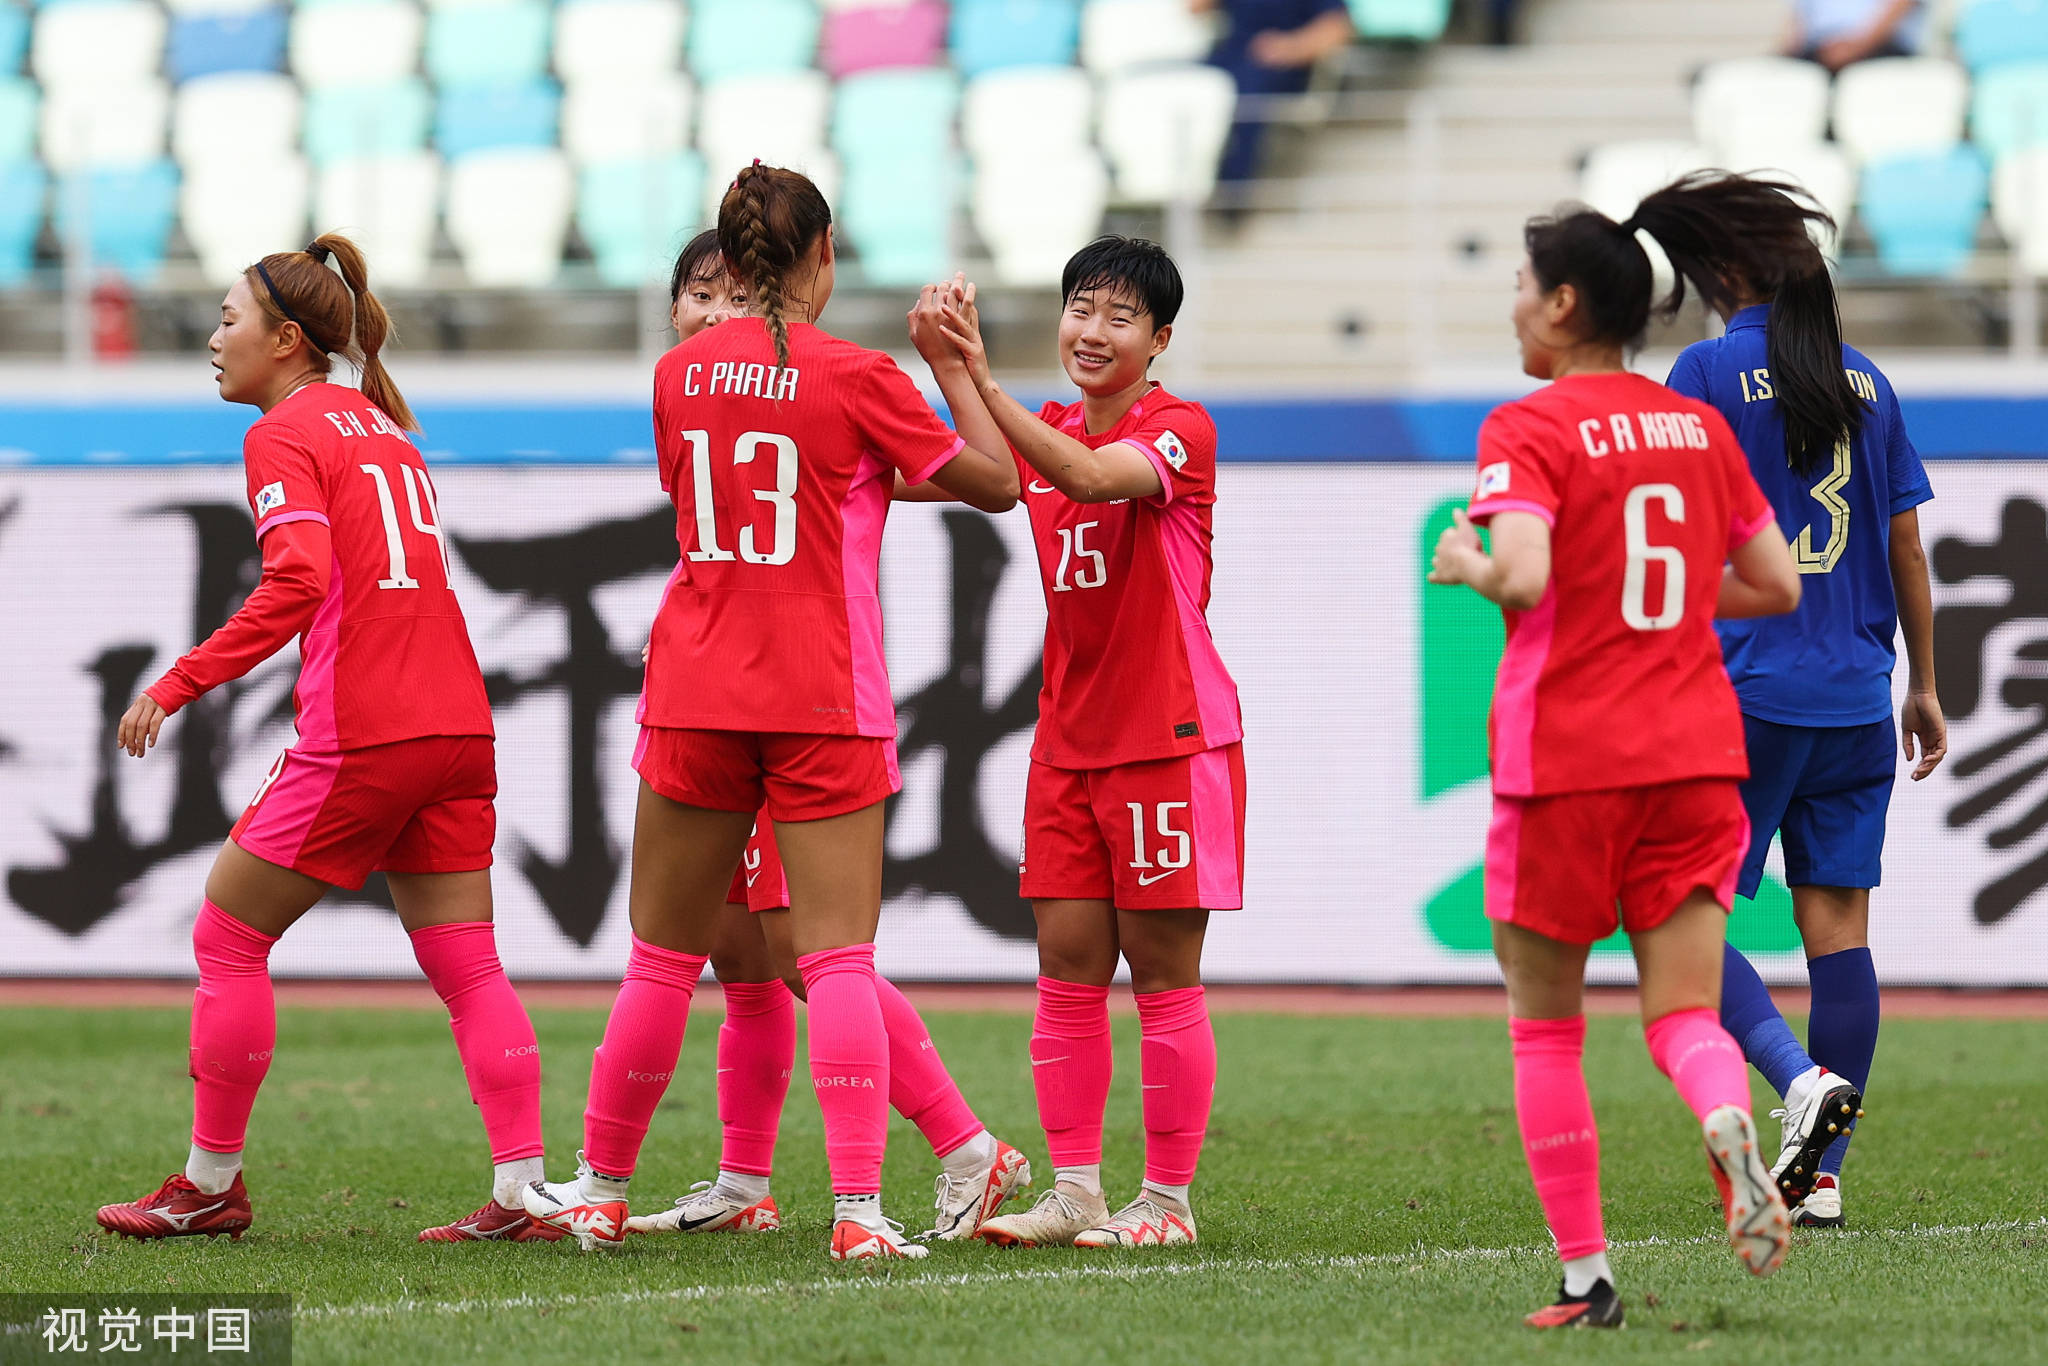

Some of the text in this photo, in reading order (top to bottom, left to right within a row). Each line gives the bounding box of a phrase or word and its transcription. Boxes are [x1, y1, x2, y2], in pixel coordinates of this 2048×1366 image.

[684, 362, 799, 401] C PHAIR
[1578, 418, 1609, 458] C
[1638, 411, 1709, 450] KANG
[360, 464, 454, 590] 14
[681, 430, 798, 566] 13
[1052, 520, 1107, 592] 15
[1621, 483, 1685, 631] 6
[1126, 801, 1191, 868] 15
[814, 1076, 875, 1089] KOREA
